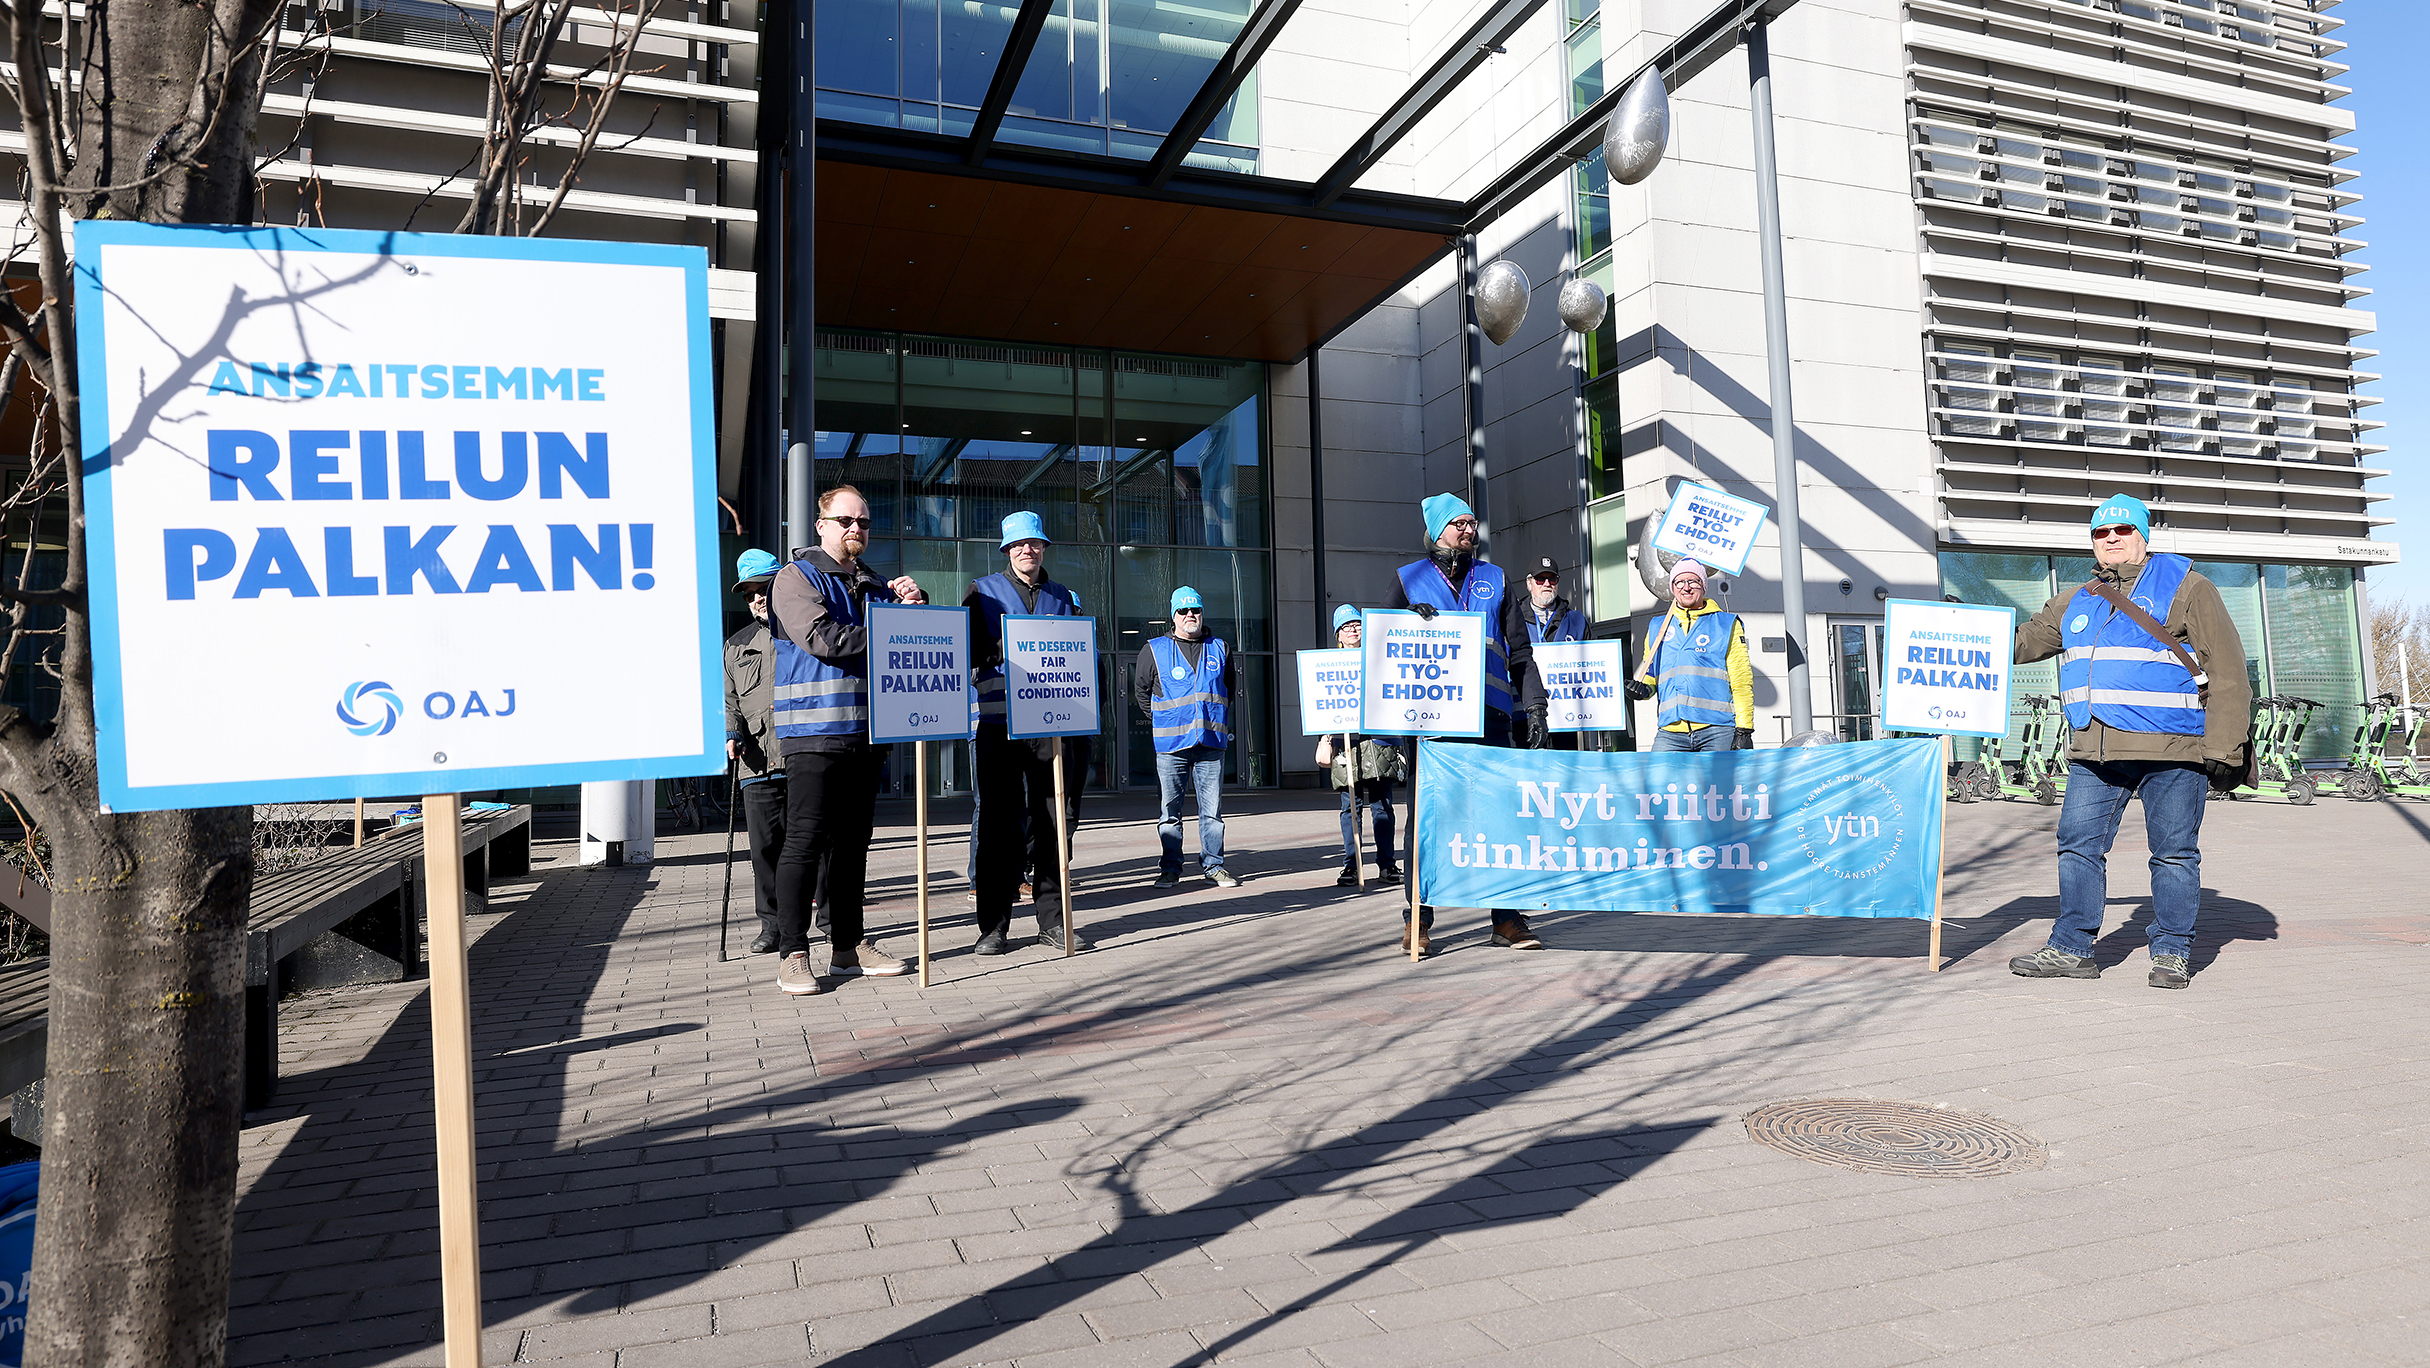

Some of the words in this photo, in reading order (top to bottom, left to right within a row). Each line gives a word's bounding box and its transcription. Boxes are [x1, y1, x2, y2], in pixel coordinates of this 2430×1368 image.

[206, 361, 606, 402] ANSAITSEMME
[207, 429, 610, 502] REILUN
[1693, 494, 1748, 516] ANSAITSEMME
[1687, 502, 1744, 527] REILUT
[2098, 506, 2130, 521] ytn
[1692, 515, 1730, 533] TYÖ-
[1674, 523, 1736, 551] EHDOT!
[1697, 546, 1714, 556] OAJ
[2337, 545, 2390, 556] Satakunnankatu
[163, 522, 656, 601] PALKAN!
[1180, 595, 1198, 606] ytn
[888, 634, 953, 646] ANSAITSEMME
[1386, 629, 1462, 639] ANSAITSEMME
[1909, 630, 1992, 645] ANSAITSEMME
[1017, 641, 1036, 652] WE
[1038, 641, 1086, 652] DESERVE
[1386, 642, 1461, 660] REILUT
[888, 651, 954, 670] REILUN
[1041, 656, 1066, 668] FAIR
[1316, 660, 1362, 668] ANSAITSEMM
[1547, 660, 1606, 669] ANSAITSEMME
[1908, 645, 1991, 668] REILUN
[1026, 672, 1082, 684] WORKING
[1397, 660, 1449, 680] TYÖ-
[1547, 671, 1606, 685] REILUN
[881, 674, 961, 693] PALKAN!
[1897, 667, 1999, 692] PALKAN!
[1017, 687, 1091, 700] CONDITIONS!
[1325, 681, 1361, 695] TYÖ-
[1382, 684, 1463, 701] EHDOT!
[423, 687, 516, 720] OAJ
[1316, 697, 1361, 710] EHDO
[922, 714, 939, 723] OAJ
[1056, 713, 1071, 721] OAJ
[1421, 712, 1441, 720] OAJ
[1946, 710, 1966, 719] OAJ
[1797, 779, 1833, 817] YLEMMÄT
[1835, 774, 1904, 817] TOIMIHENKILÖT
[1516, 780, 1616, 830] Nyt
[1635, 783, 1773, 822] riitti
[1797, 826, 1806, 840] DE
[1823, 811, 1880, 846] ytn
[1448, 833, 1769, 872] tinkiminen.
[1801, 842, 1831, 873] HÖGRE
[1834, 829, 1904, 880] TJÄNSTEMÄNNEN
